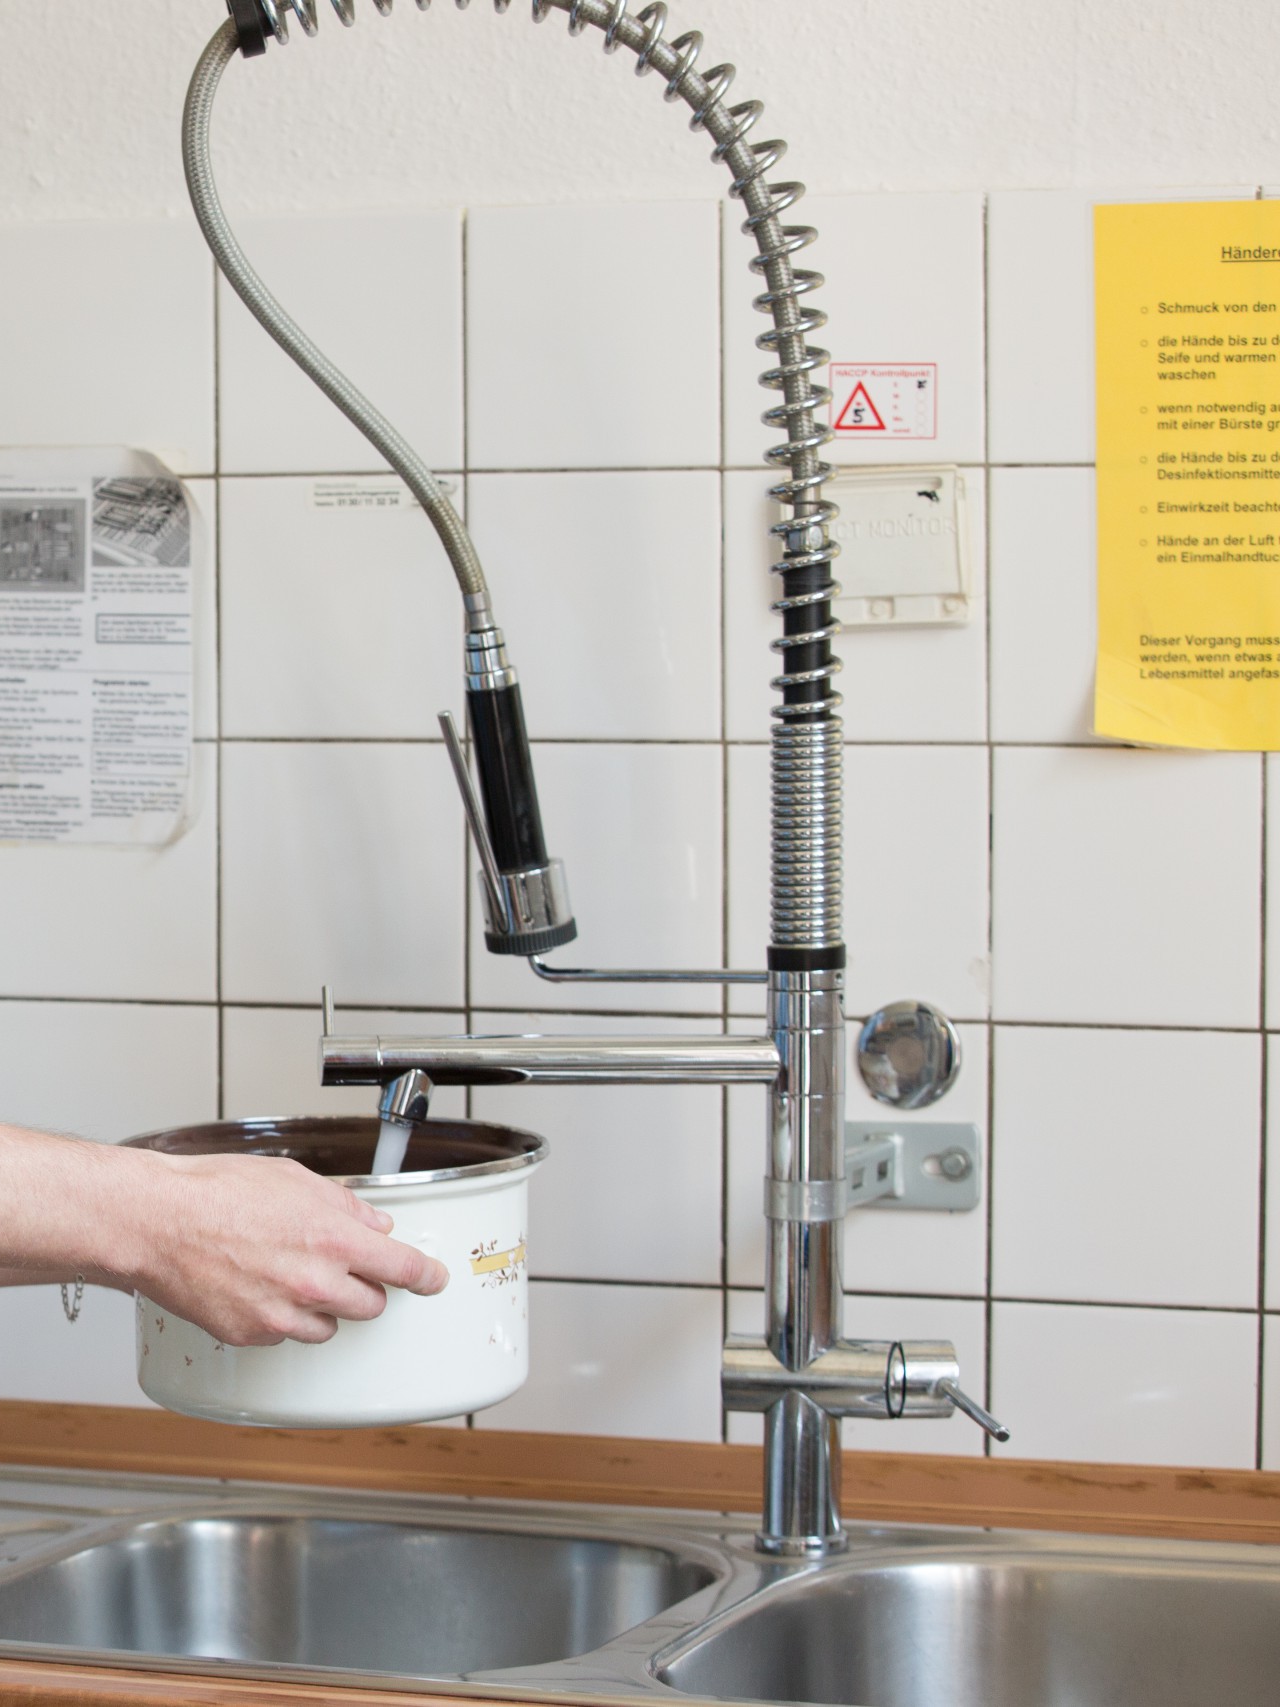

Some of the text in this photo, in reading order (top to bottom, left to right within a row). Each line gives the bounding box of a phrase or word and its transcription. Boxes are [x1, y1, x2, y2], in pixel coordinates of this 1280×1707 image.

[1158, 301, 1276, 314] Schmuck von den
[1157, 336, 1177, 347] die
[1182, 335, 1224, 346] Hände
[1228, 335, 1248, 346] bis
[1252, 337, 1267, 346] zu
[1158, 352, 1276, 364] Seife und warmen
[1157, 369, 1216, 380] waschen
[1157, 404, 1192, 414] wenn
[1197, 402, 1266, 415] notwendig
[1157, 419, 1178, 430] mit
[1182, 419, 1215, 429] einer
[1219, 418, 1263, 429] Bürste
[1157, 452, 1176, 463] die
[1181, 451, 1223, 463] Hände
[1227, 451, 1247, 462] bis
[1251, 453, 1266, 462] zu
[1157, 502, 1229, 513] Einwirkzeit
[1157, 535, 1274, 546] Hände an der Luft
[1157, 552, 1176, 563] ein
[1140, 635, 1280, 648] Dieser Vorgang muss
[1140, 652, 1191, 663] werden,
[1195, 653, 1230, 662] wenn
[1234, 652, 1272, 662] etwas
[1140, 667, 1280, 681] Lebensmittel angefas
